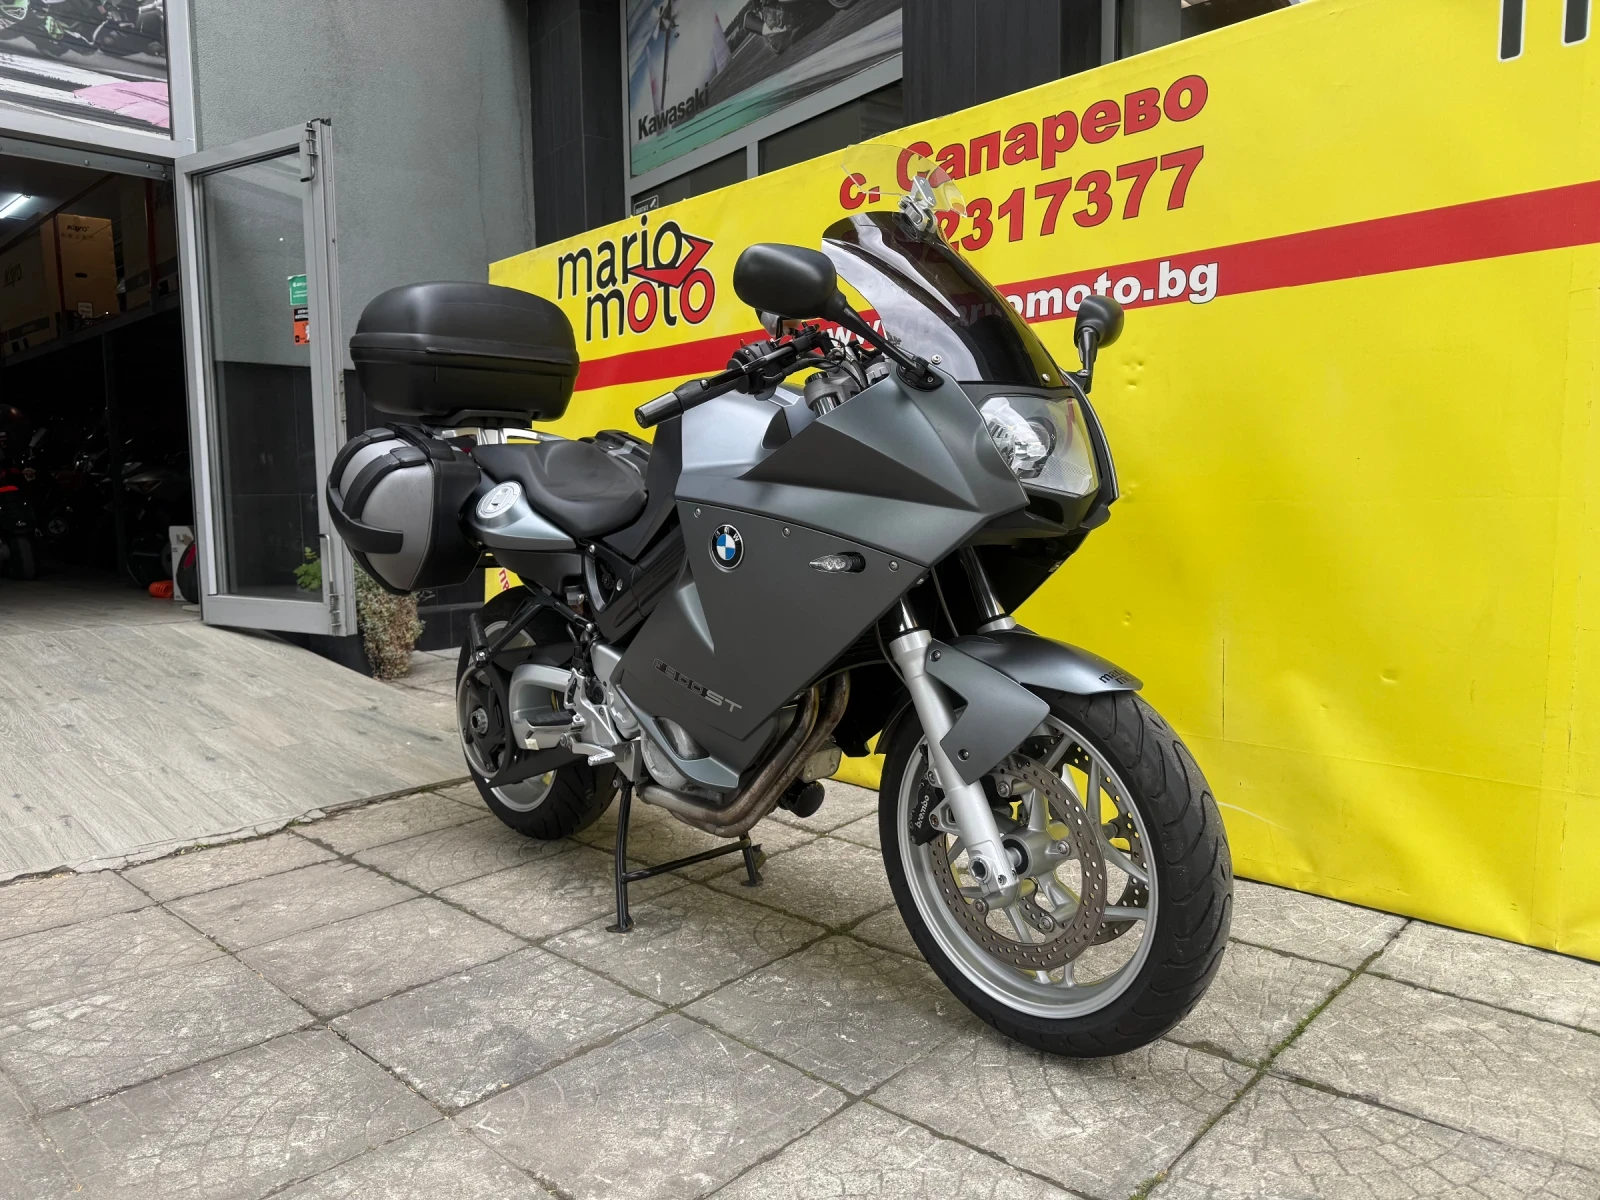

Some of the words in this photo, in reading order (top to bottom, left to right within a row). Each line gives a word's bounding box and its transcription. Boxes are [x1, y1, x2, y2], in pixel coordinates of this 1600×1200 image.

[638, 82, 709, 140] Kawasaki
[896, 74, 1209, 192] Сапарево
[558, 214, 683, 300] mario
[586, 268, 716, 342] moto
[914, 794, 930, 829] brembo
